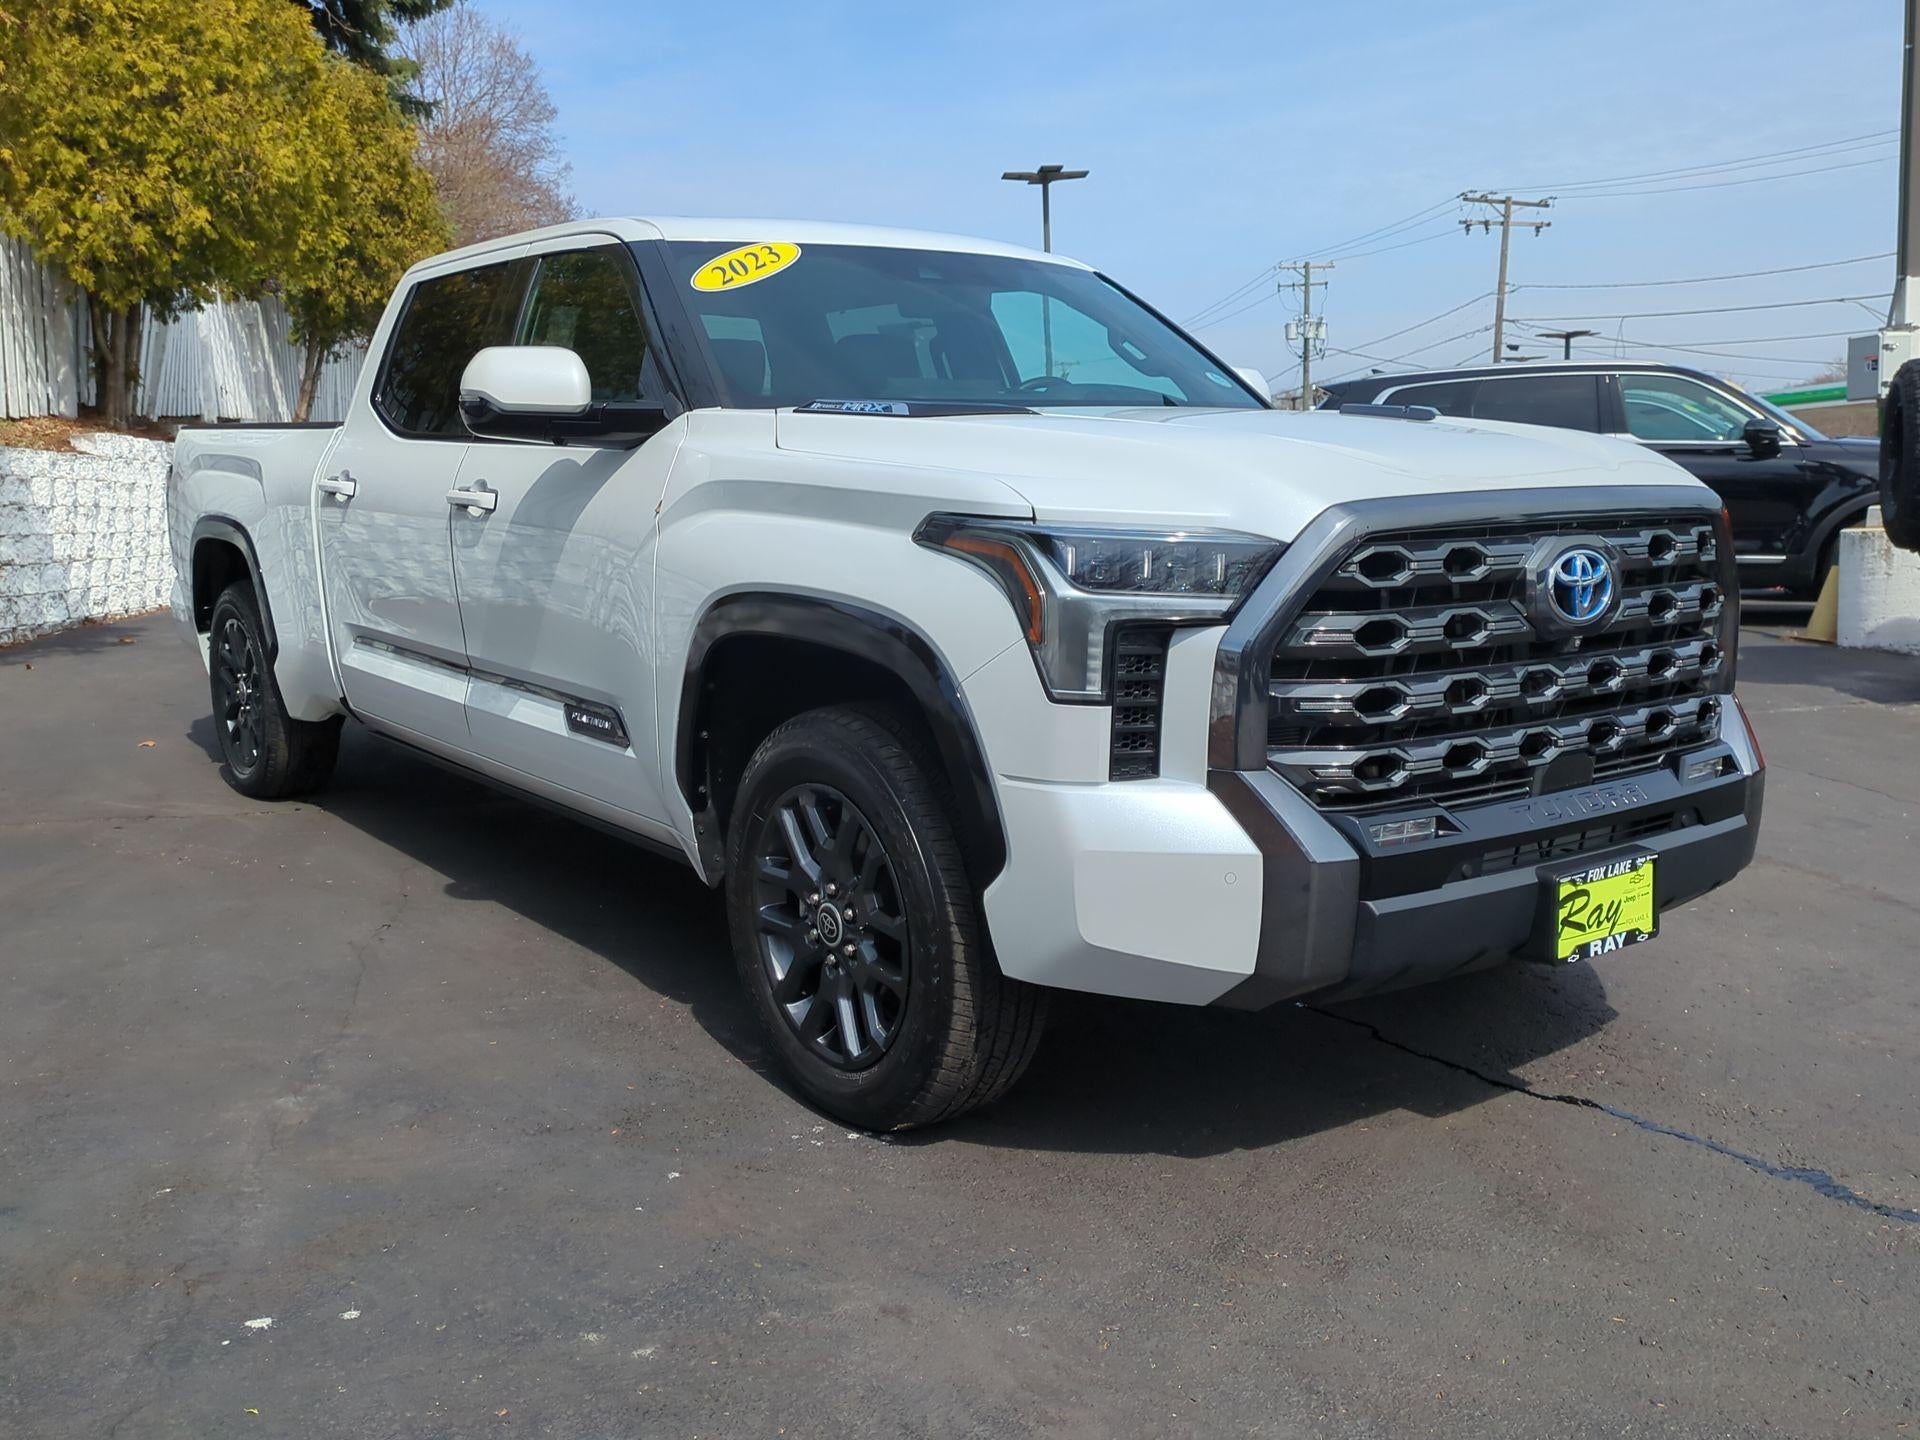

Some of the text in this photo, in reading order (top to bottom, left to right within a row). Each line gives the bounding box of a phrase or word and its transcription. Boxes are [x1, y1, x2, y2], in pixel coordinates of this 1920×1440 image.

[711, 245, 781, 285] 2023
[571, 711, 612, 730] PLATINUM
[1509, 782, 1648, 824] TUNDRA
[1587, 866, 1606, 882] FOX
[1607, 860, 1632, 877] LAKE
[1559, 888, 1624, 938] Ray
[1590, 931, 1627, 957] RAY
